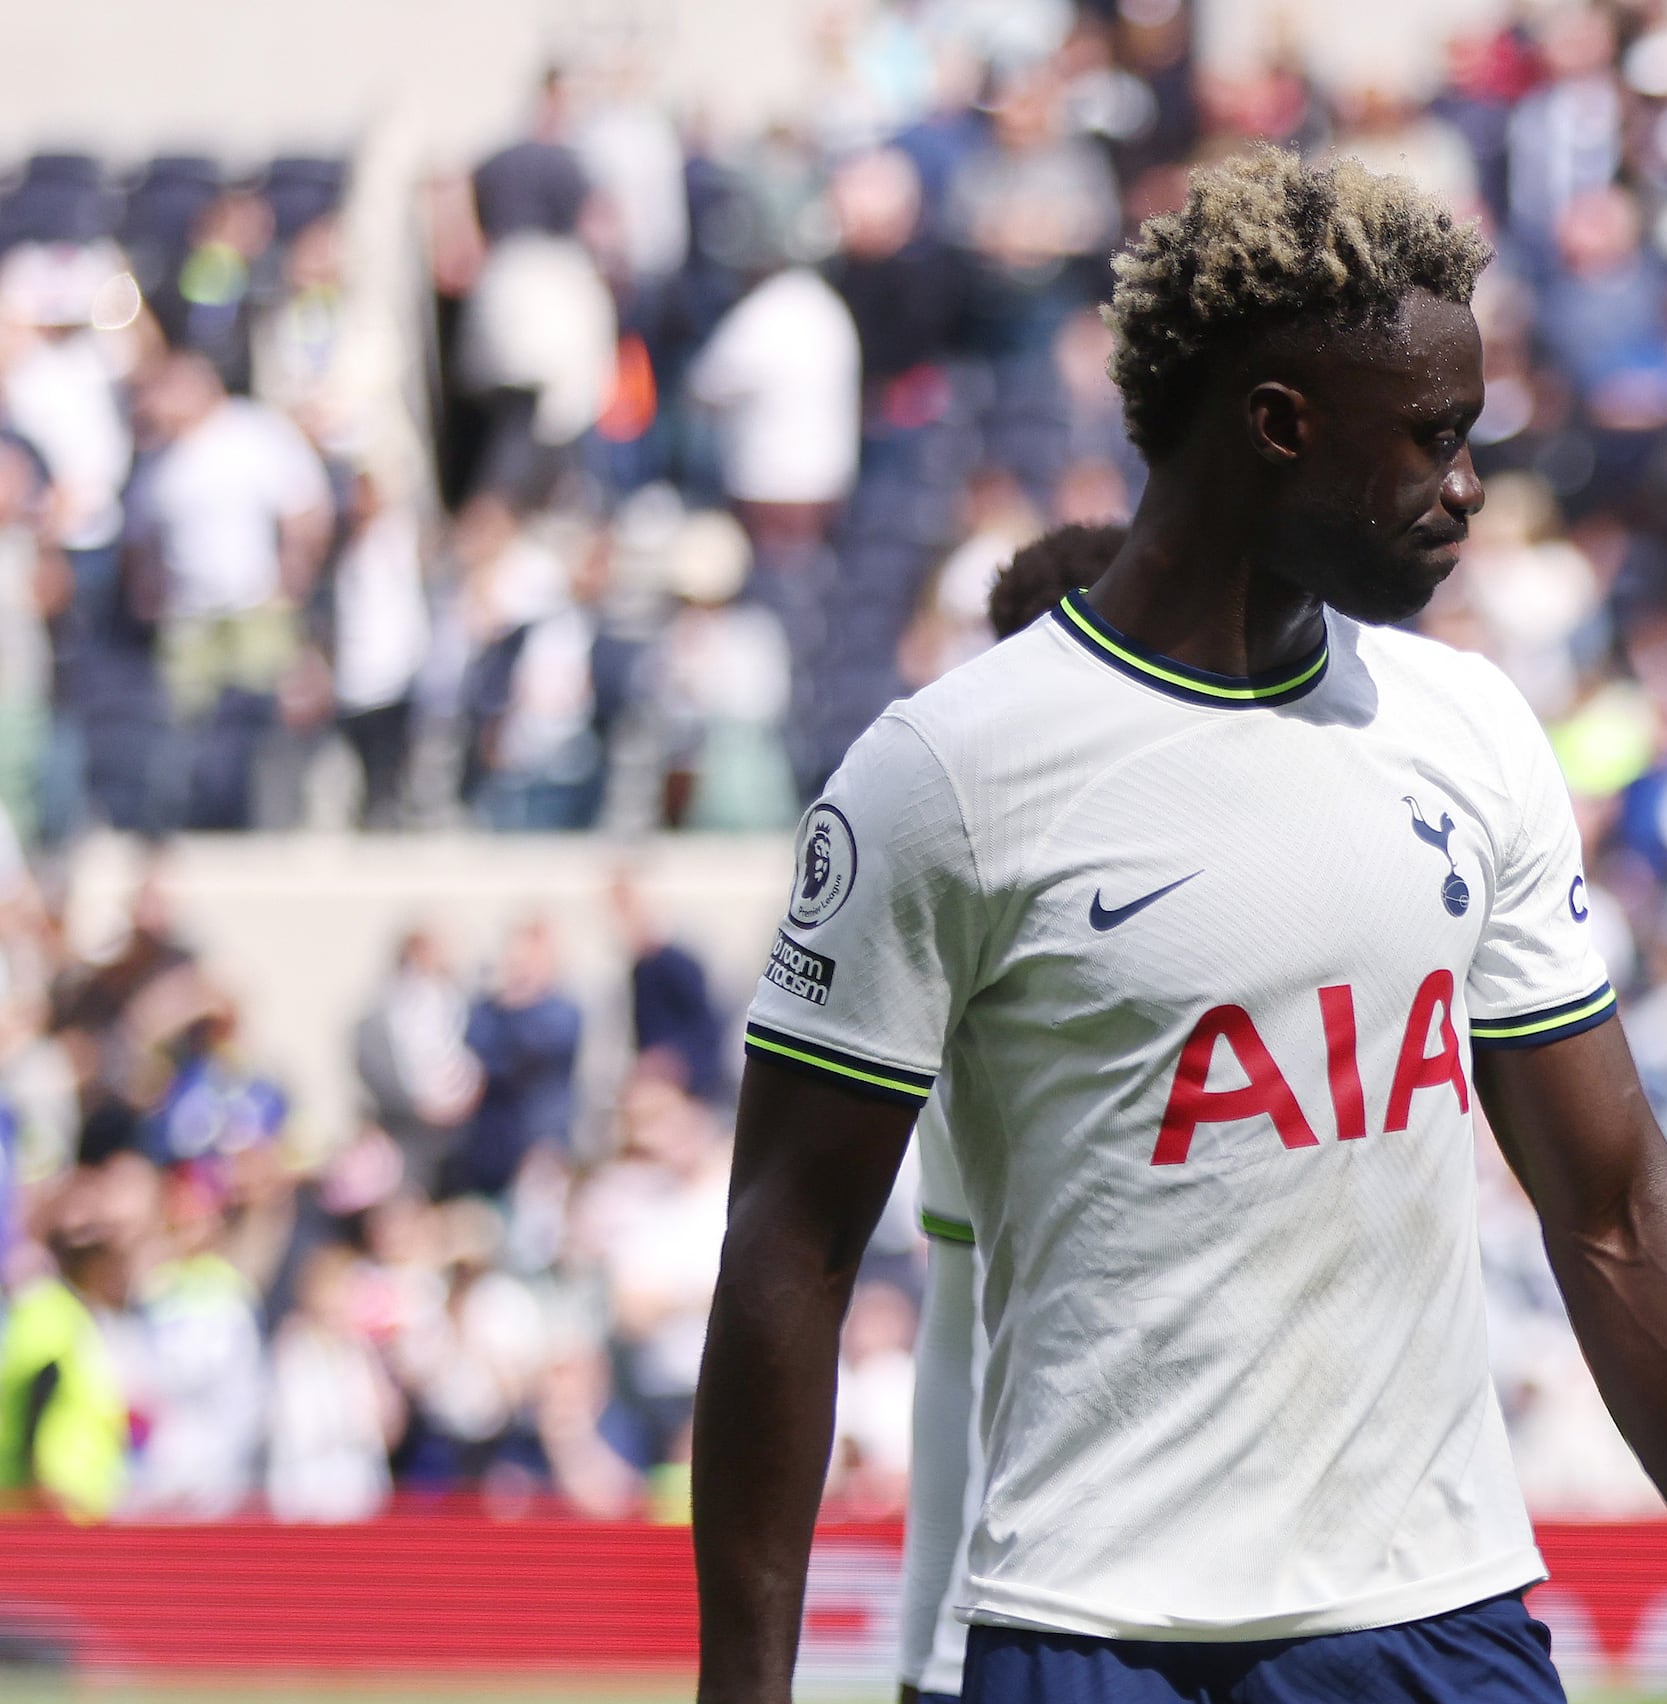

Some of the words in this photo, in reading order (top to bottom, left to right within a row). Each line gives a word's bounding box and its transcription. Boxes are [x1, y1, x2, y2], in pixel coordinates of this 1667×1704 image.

[779, 942, 823, 981] room
[769, 963, 828, 1004] racism
[1150, 969, 1469, 1166] AIA
